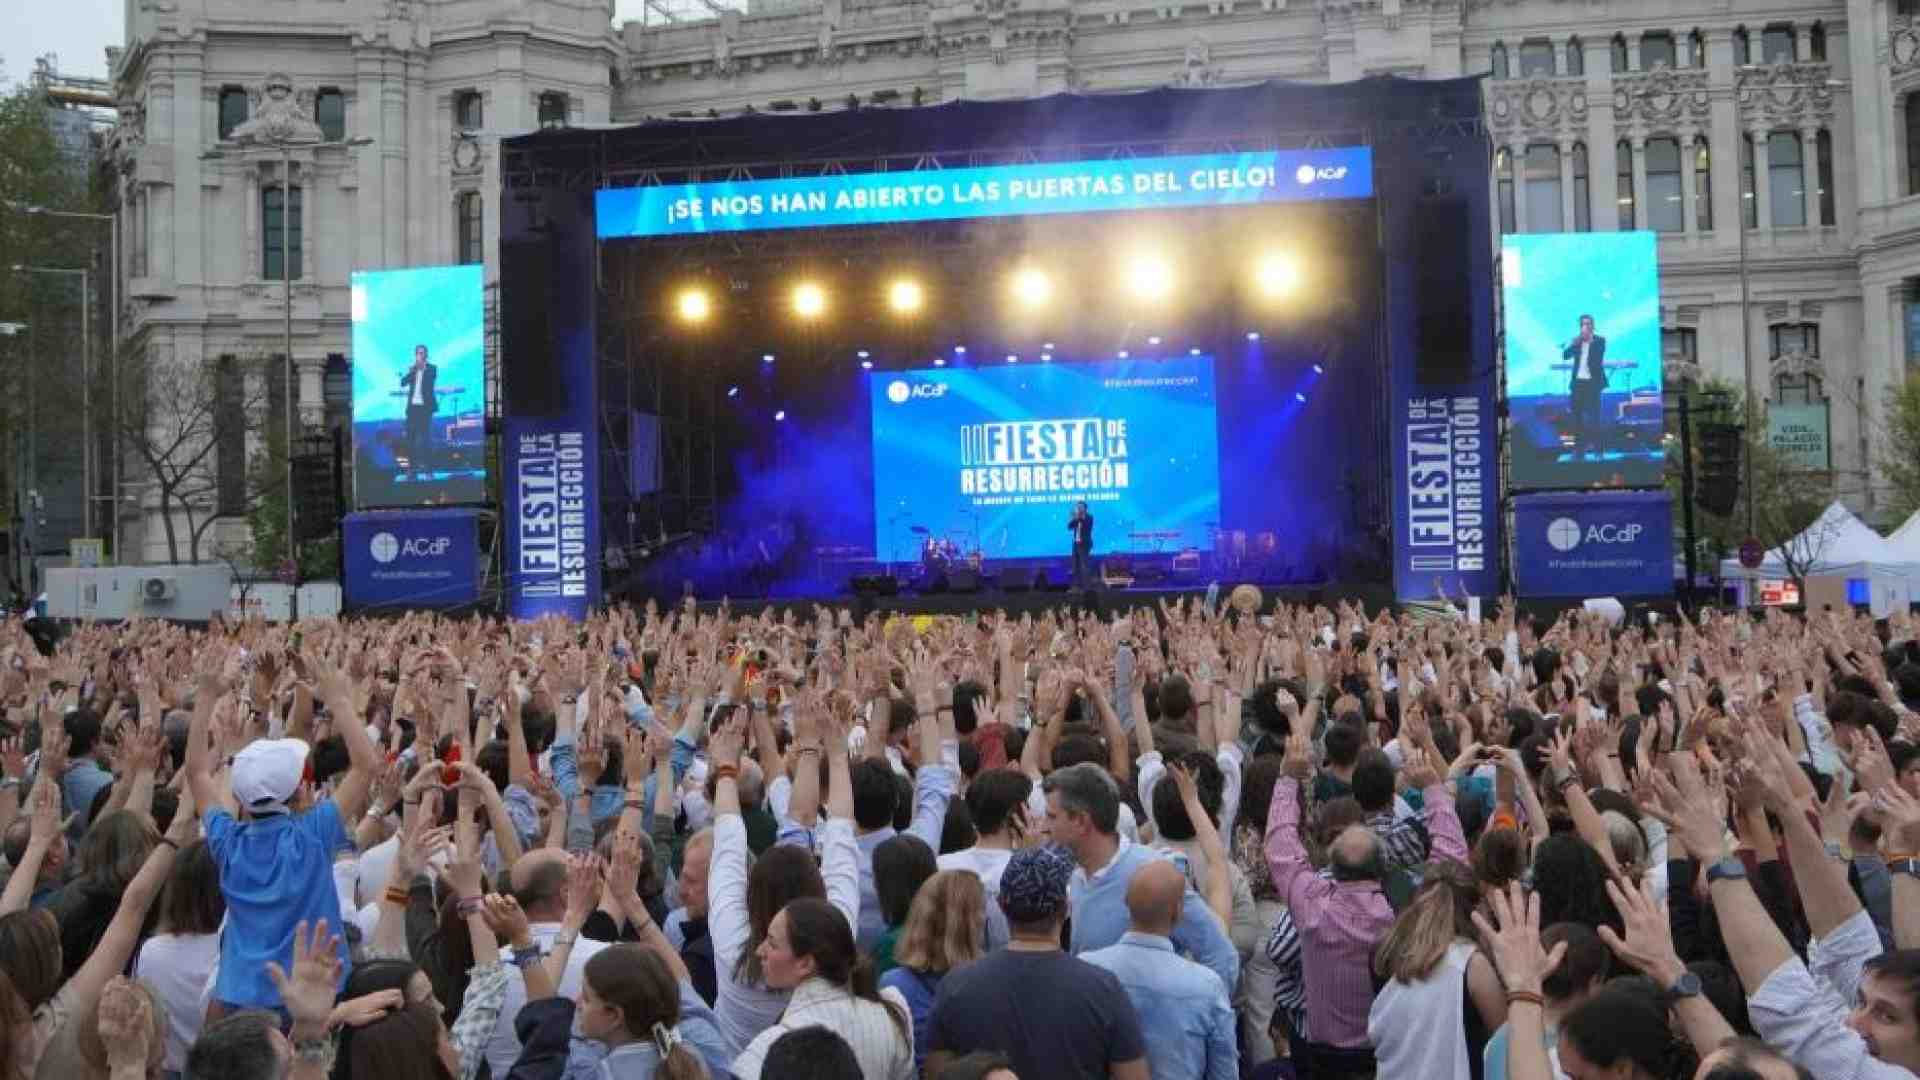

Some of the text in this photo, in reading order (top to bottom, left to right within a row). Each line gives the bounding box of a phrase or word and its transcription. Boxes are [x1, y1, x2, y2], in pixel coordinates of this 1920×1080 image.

[667, 165, 1277, 224] ¡SE NOS HAN ABIERTO LAS PUERTAS DEL CIELO!
[1409, 398, 1427, 419] DE
[1428, 398, 1448, 418] LA
[1106, 419, 1128, 437] DE
[519, 432, 536, 454] DE
[537, 432, 555, 453] LA
[986, 419, 1102, 464] FIESTA
[1108, 439, 1128, 458] LA
[960, 459, 1129, 495] RESURRECCIÓN
[1408, 425, 1452, 545] FIESTA
[1451, 397, 1483, 571] RESURRECCIÓN
[519, 460, 558, 571] FIESTA
[555, 432, 586, 597] RESURRECCIÓN
[1585, 523, 1642, 543] ACdP
[402, 536, 451, 556] ACdP
